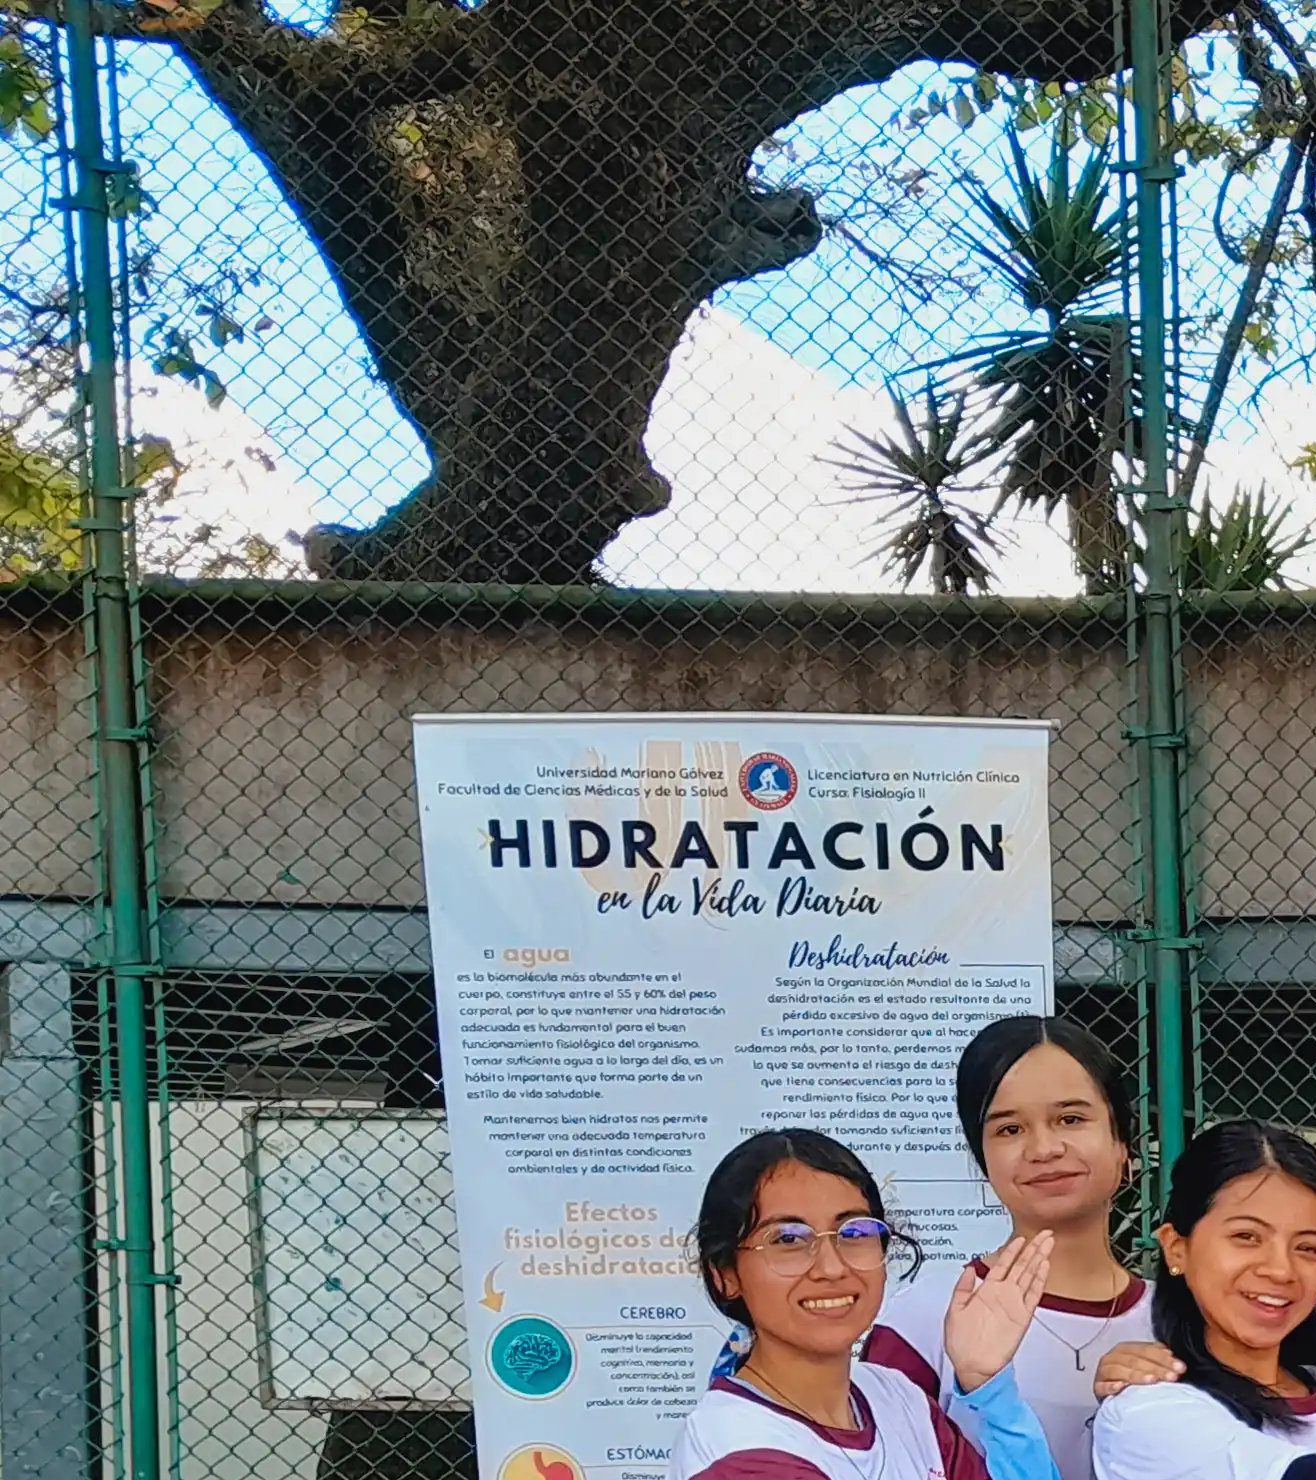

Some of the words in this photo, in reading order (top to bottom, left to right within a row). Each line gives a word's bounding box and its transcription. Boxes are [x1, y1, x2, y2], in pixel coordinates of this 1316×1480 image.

[537, 766, 617, 778] Universidad
[621, 768, 676, 779] Mariano
[679, 768, 724, 780] Gálvez
[808, 769, 890, 781] Licenciatura
[893, 772, 909, 781] en
[913, 771, 972, 782] Nutrición
[976, 771, 1019, 783] Clínica
[438, 783, 500, 795] Facultad
[504, 784, 521, 795] de
[524, 784, 581, 796] Ciencias
[584, 784, 640, 796] Médicas
[644, 788, 651, 799] y
[655, 785, 671, 796] de
[675, 785, 687, 797] la
[691, 786, 728, 797] Salud
[853, 787, 915, 801] Fisiología
[919, 788, 925, 799] II
[488, 805, 1004, 871] HIDRATACIÓN
[597, 890, 631, 914] en
[642, 872, 681, 920] la
[692, 875, 766, 918] Vida
[776, 875, 882, 918] Diaria
[484, 949, 494, 959] El
[503, 947, 571, 968] agua
[788, 933, 950, 970] Deshidratación
[473, 972, 484, 982] la
[487, 972, 558, 982] biomolécula
[561, 972, 586, 982] más
[589, 972, 652, 982] abundante
[671, 972, 681, 982] el
[776, 977, 811, 989] Según
[814, 977, 824, 986] la
[828, 977, 904, 989] Organización
[907, 977, 951, 987] Mundial
[954, 978, 969, 987] de
[972, 978, 982, 987] la
[985, 978, 1017, 988] Salud
[1020, 978, 1030, 988] la
[506, 990, 565, 1000] constituye
[569, 990, 601, 999] entre
[604, 989, 613, 998] el
[617, 989, 631, 998] 55
[634, 992, 640, 1000] y
[644, 989, 666, 998] 60%
[669, 989, 686, 998] del
[689, 991, 717, 1000] peso
[768, 994, 854, 1003] deshidratación
[874, 994, 883, 1003] el
[887, 995, 927, 1004] estado
[930, 995, 989, 1004] resultante
[993, 994, 1007, 1004] de
[516, 1008, 534, 1017] por
[551, 1008, 572, 1018] que
[575, 1007, 633, 1015] mantener
[660, 1006, 725, 1015] hidratación
[461, 1023, 520, 1032] adecuada
[539, 1023, 612, 1032] fundamental
[616, 1024, 643, 1034] para
[645, 1023, 655, 1032] el
[657, 1023, 686, 1032] buen
[462, 1039, 553, 1049] funcionamiento
[556, 1039, 615, 1051] fisiológico
[618, 1039, 635, 1048] del
[465, 1073, 504, 1082] hábito
[508, 1073, 572, 1084] importante
[575, 1075, 597, 1084] que
[600, 1072, 635, 1081] forma
[638, 1073, 668, 1083] parte
[671, 1071, 685, 1081] de
[688, 1074, 702, 1082] un
[467, 1089, 499, 1099] estilo
[502, 1089, 516, 1098] de
[520, 1089, 543, 1098] vida
[489, 1132, 545, 1140] mantener
[572, 1131, 630, 1141] adecuada
[633, 1132, 705, 1141] temperatura
[505, 1148, 553, 1159] corporal
[572, 1148, 623, 1157] distintas
[625, 1147, 692, 1156] condiciones
[508, 1164, 578, 1174] ambientales
[581, 1166, 588, 1176] y
[591, 1164, 605, 1173] de
[608, 1164, 660, 1173] actividad
[565, 1201, 657, 1222] Efectos
[504, 1227, 651, 1254] fisiológicos
[620, 1306, 686, 1320] CEREBRO
